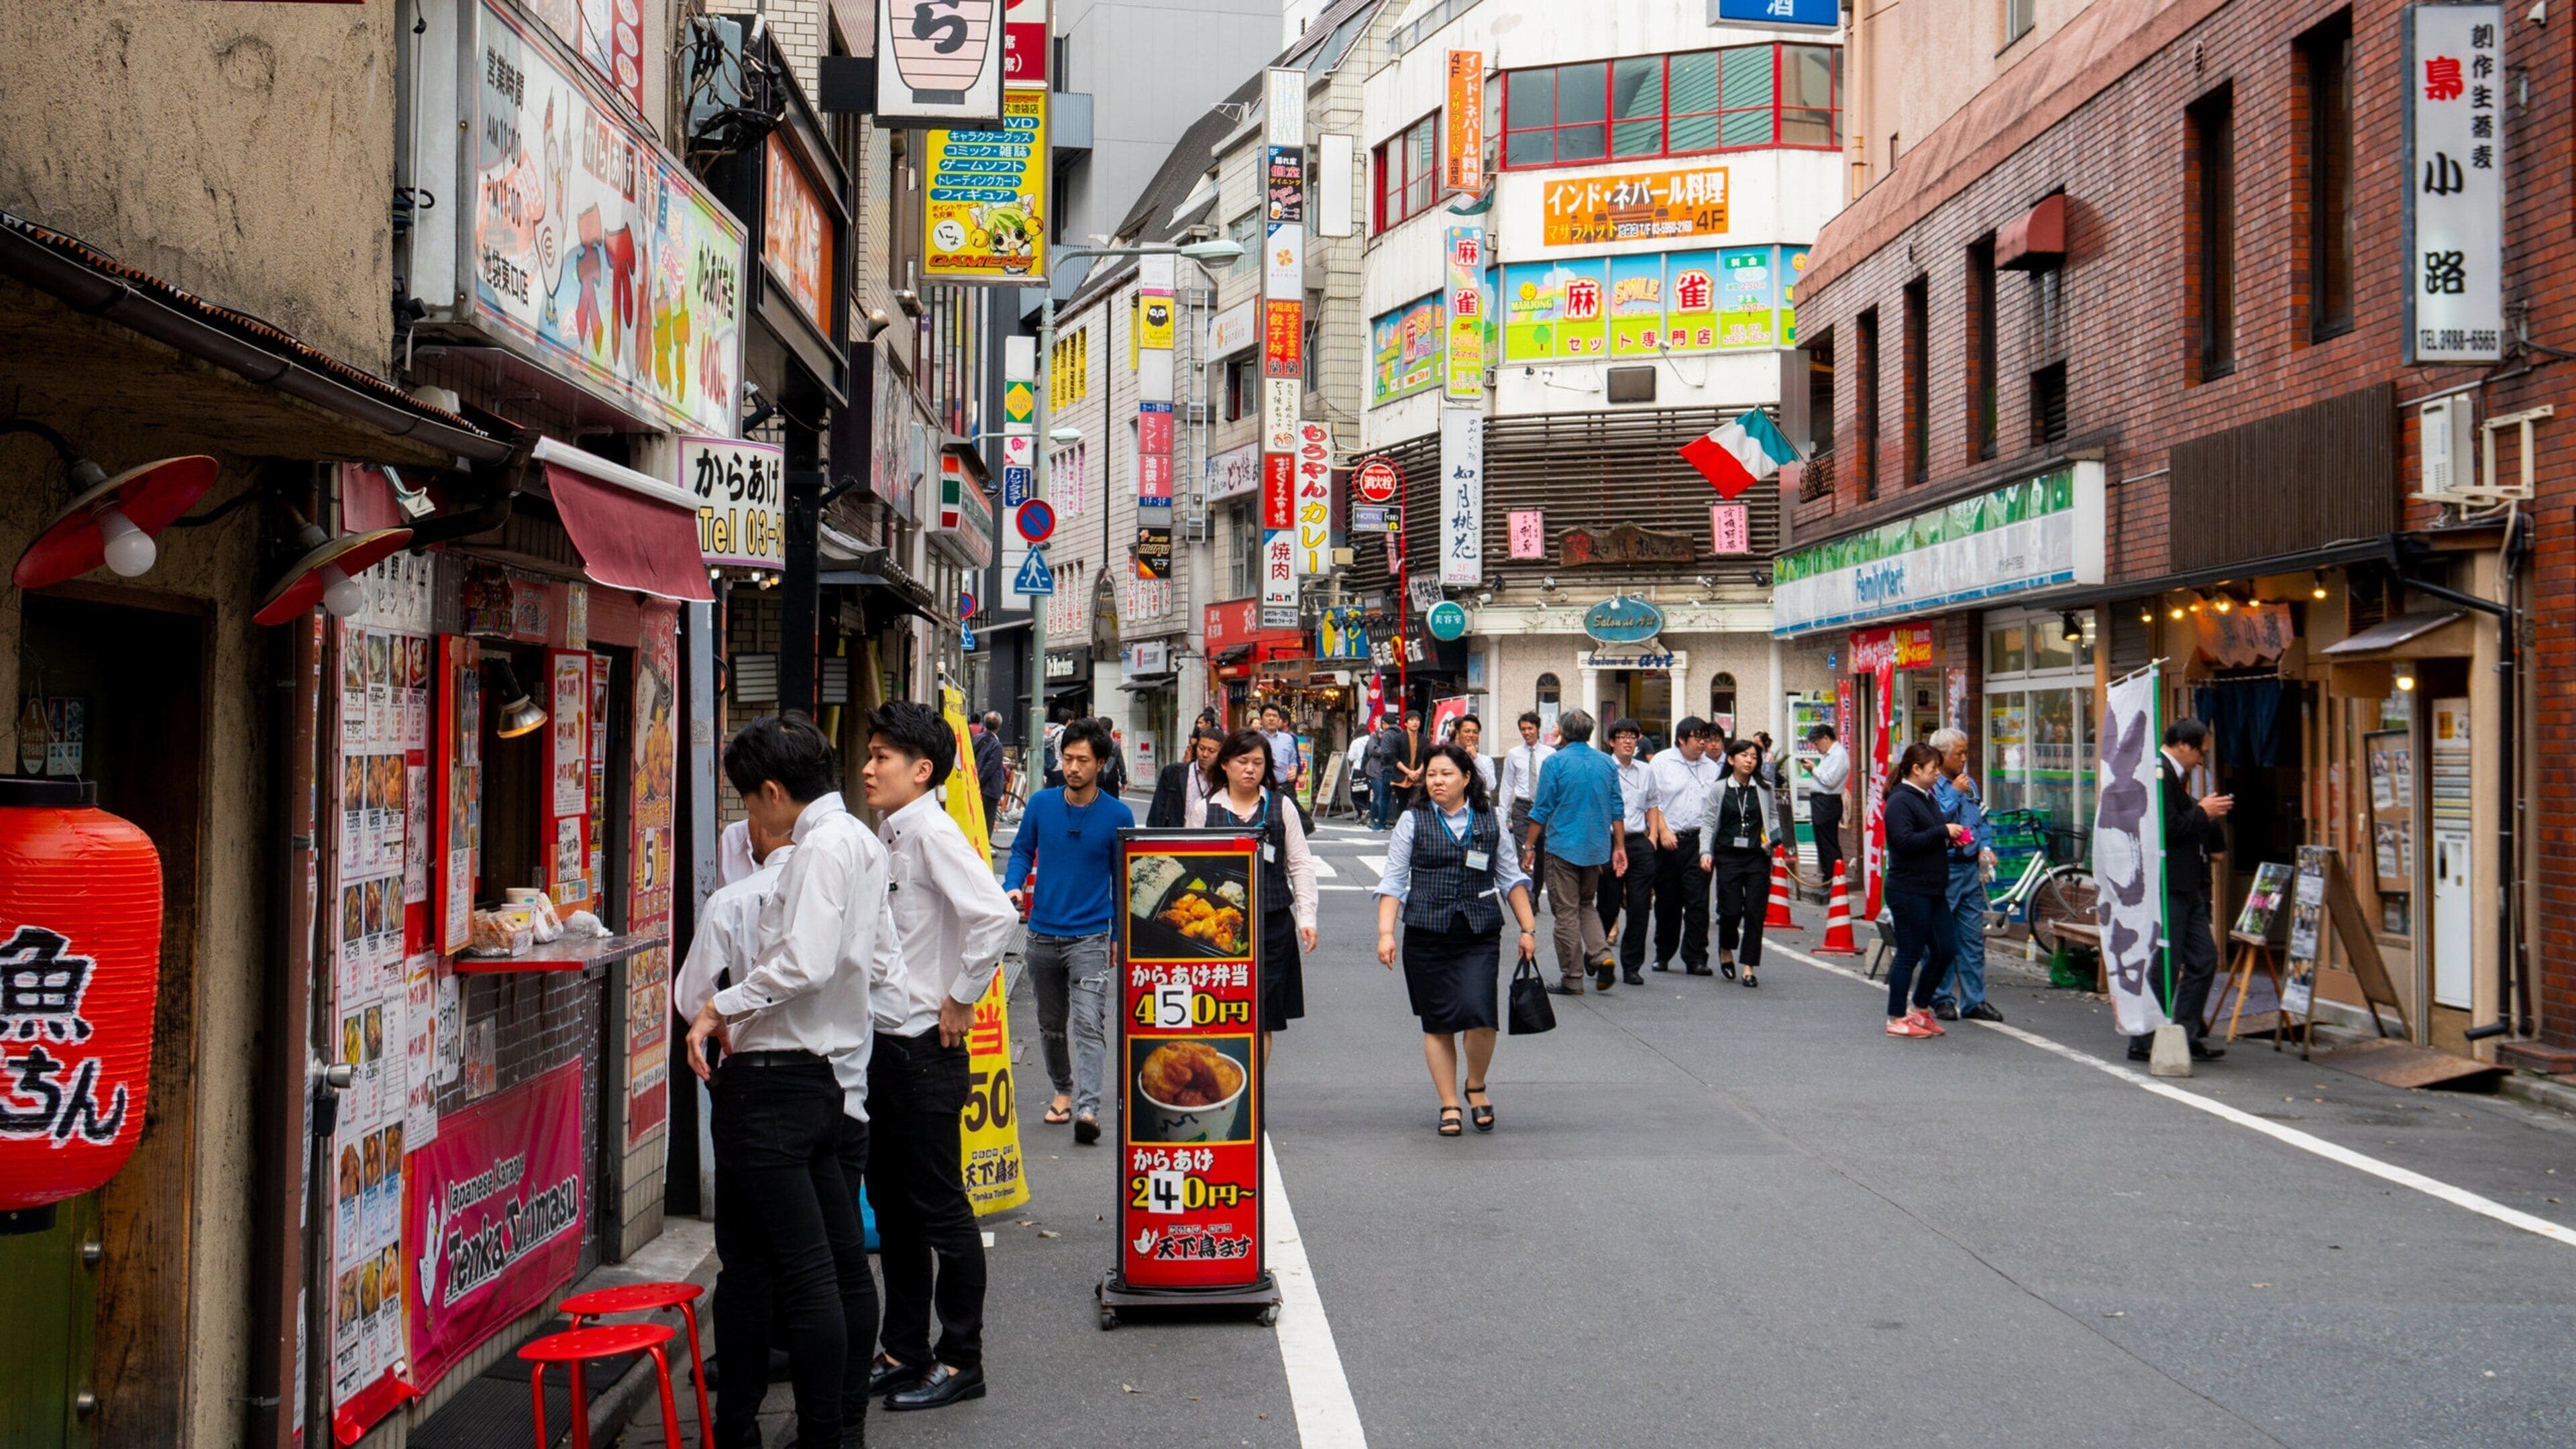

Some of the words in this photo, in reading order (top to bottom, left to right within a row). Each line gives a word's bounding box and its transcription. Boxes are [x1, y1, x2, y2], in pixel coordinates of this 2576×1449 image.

[912, 0, 967, 54] ら
[486, 44, 525, 112] 営業時間
[1451, 53, 1460, 78] 4F
[1451, 91, 1460, 155] マサラハット
[1463, 54, 1479, 186] インド・ネパール料理
[950, 131, 1031, 143] キャラクターグッズ
[582, 107, 636, 203] からあげ
[941, 160, 1024, 172] ゲームソフト
[946, 146, 1028, 158] コミック・雑誌
[938, 174, 1021, 186] トレーディングカード
[1271, 165, 1301, 178] 個室
[1450, 158, 1460, 185] 池袋店
[939, 189, 1012, 201] フィギュア
[1548, 172, 1725, 216] インド・ネパール料理
[1548, 221, 1618, 240] マサラハット
[1696, 209, 1725, 231] 4F
[938, 225, 960, 246] にょ
[482, 241, 529, 309] 池袋東口店
[929, 255, 1037, 268] GAMERS
[1455, 239, 1478, 316] 麻雀
[1613, 276, 1660, 305] SMILE
[1678, 273, 1708, 310] 雀
[1511, 299, 1553, 311] MAHJONG
[1567, 280, 1596, 318] 麻
[1269, 313, 1285, 356] 餃子坊
[1568, 327, 1714, 351] セット専門店
[2420, 329, 2437, 350] TEL
[1146, 417, 1157, 451] ミント
[694, 447, 780, 507] からあげ
[1145, 456, 1157, 494] 池袋店
[1364, 475, 1393, 490] 消火栓
[1301, 424, 1328, 574] もうやんカレー
[698, 506, 737, 553] Tel
[1356, 512, 1381, 521] HOTEL
[1271, 541, 1291, 580] 焼肉
[1856, 561, 1905, 603] FamilyMart
[1435, 614, 1462, 625] 美容室
[1594, 614, 1621, 628] Salon
[1622, 615, 1633, 626] de
[1634, 614, 1656, 627] Art
[0, 924, 97, 1046] 魚
[1132, 963, 1249, 988] からあげ弁当
[1135, 990, 1250, 1026] 450円
[0, 1046, 128, 1147] ちん
[1134, 1148, 1215, 1172] からあげ
[448, 1174, 494, 1217] Japanese
[494, 1150, 526, 1193] Karaage
[972, 1191, 992, 1202] Tenka
[447, 1214, 505, 1298] Tenka
[504, 1175, 578, 1253] Torimasu
[1157, 1232, 1252, 1259] 天下鳥ます
